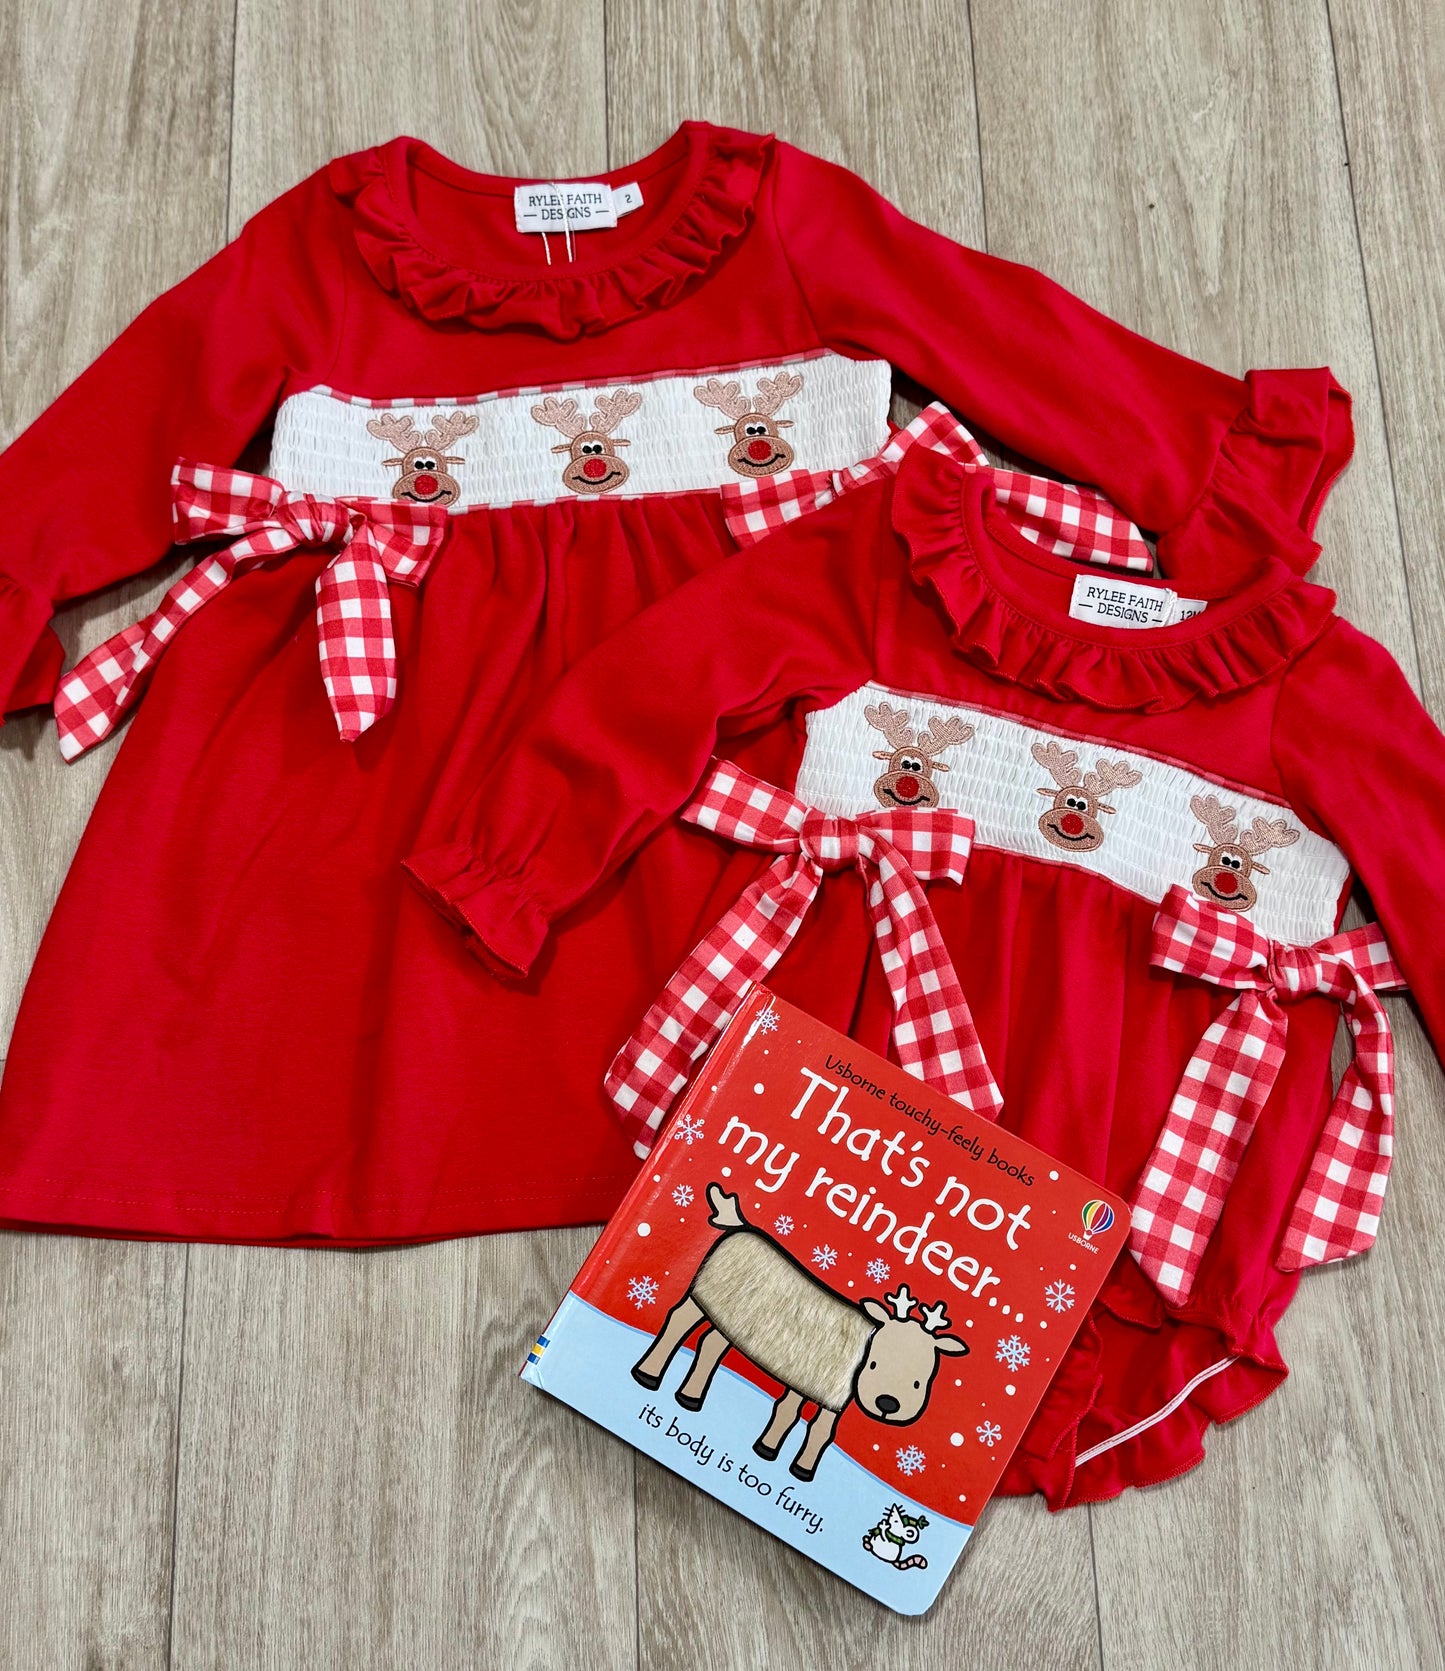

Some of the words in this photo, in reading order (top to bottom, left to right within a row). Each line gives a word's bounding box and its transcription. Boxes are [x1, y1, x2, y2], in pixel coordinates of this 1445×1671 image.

[567, 193, 602, 206] FAITH
[624, 194, 632, 204] 2
[541, 206, 591, 220] DESGNS
[1087, 587, 1126, 603] RYLEE
[1128, 595, 1163, 612] FAITH
[1098, 603, 1148, 623] DESIGNS
[825, 1054, 886, 1101] Usborne
[889, 1093, 984, 1161] touchy-feely
[988, 1147, 1035, 1187] books
[790, 1067, 931, 1188] That's
[935, 1175, 1032, 1251] not
[717, 1115, 800, 1194] my
[804, 1167, 1024, 1323] reindeer...
[1068, 1232, 1099, 1255] USBORNE
[638, 1403, 662, 1429] its
[665, 1417, 714, 1466] body
[718, 1452, 734, 1473] is
[738, 1463, 773, 1497] too
[776, 1486, 825, 1534] furry.
